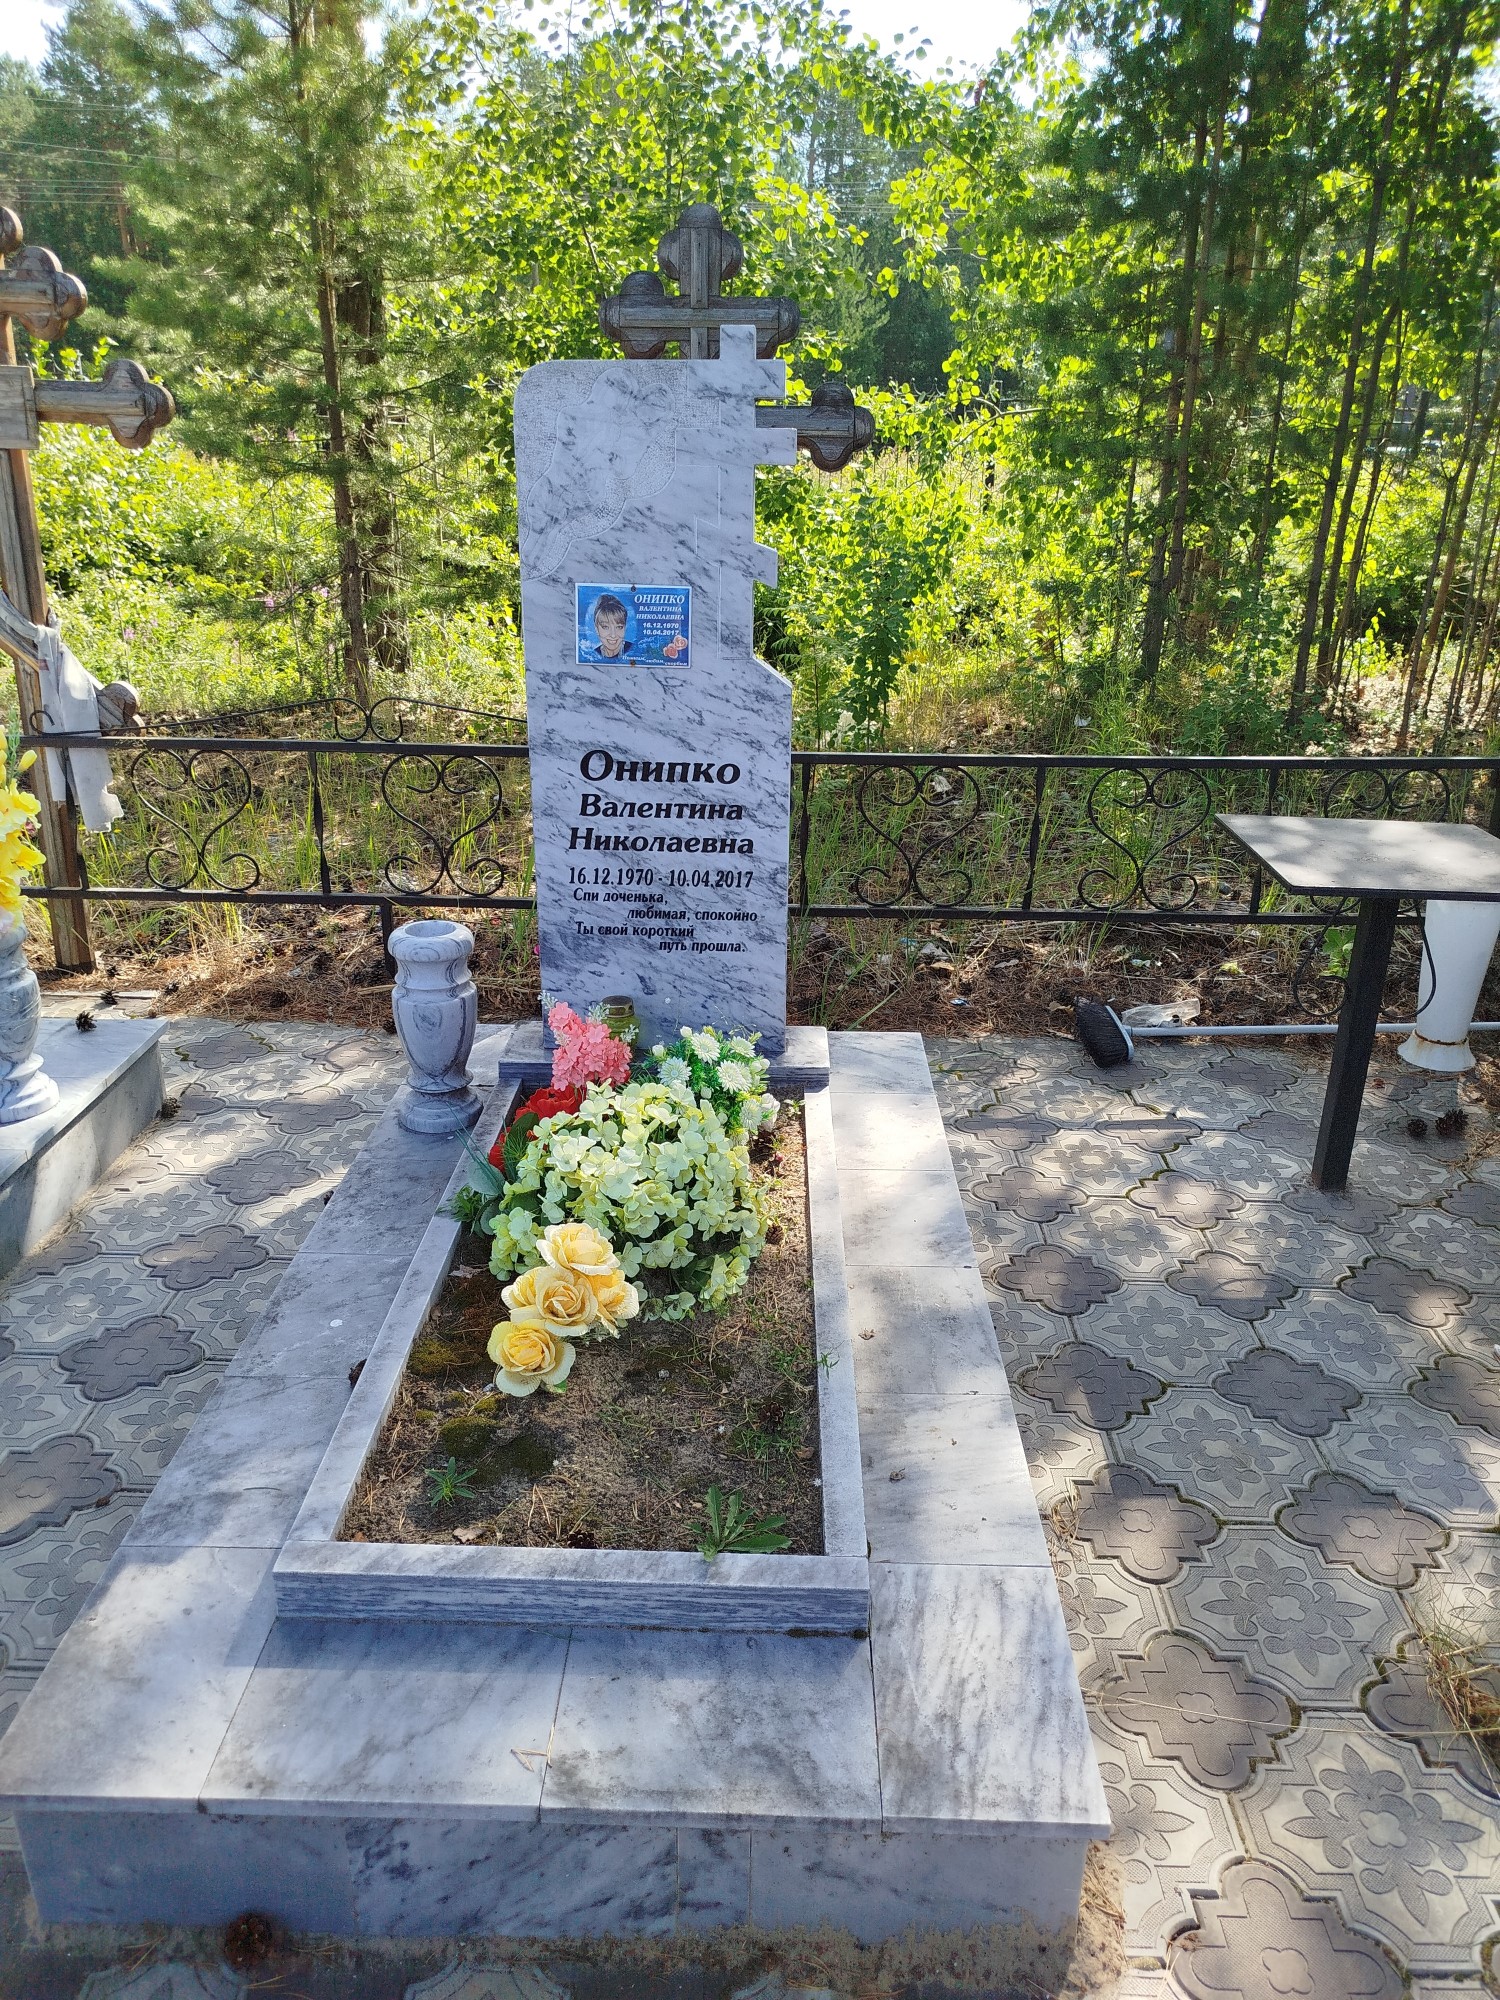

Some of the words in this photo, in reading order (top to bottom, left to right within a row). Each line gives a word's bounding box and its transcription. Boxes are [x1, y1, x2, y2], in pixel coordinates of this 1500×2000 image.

[634, 594, 685, 604] ОНИПКО
[579, 749, 741, 785] Онипко
[579, 793, 743, 821] Валентина
[568, 827, 754, 854] Николаевна
[568, 867, 654, 886] 16.12.1970
[669, 869, 753, 888] 10.04.2017
[573, 888, 599, 902] Спи
[603, 892, 668, 906] доченька,
[627, 907, 690, 922] любимая,
[695, 908, 758, 922] спокойно
[576, 921, 594, 935] Ты
[598, 923, 628, 936] свой
[632, 925, 694, 938] короткий
[659, 941, 687, 954] путь
[691, 941, 746, 954] прошла.
